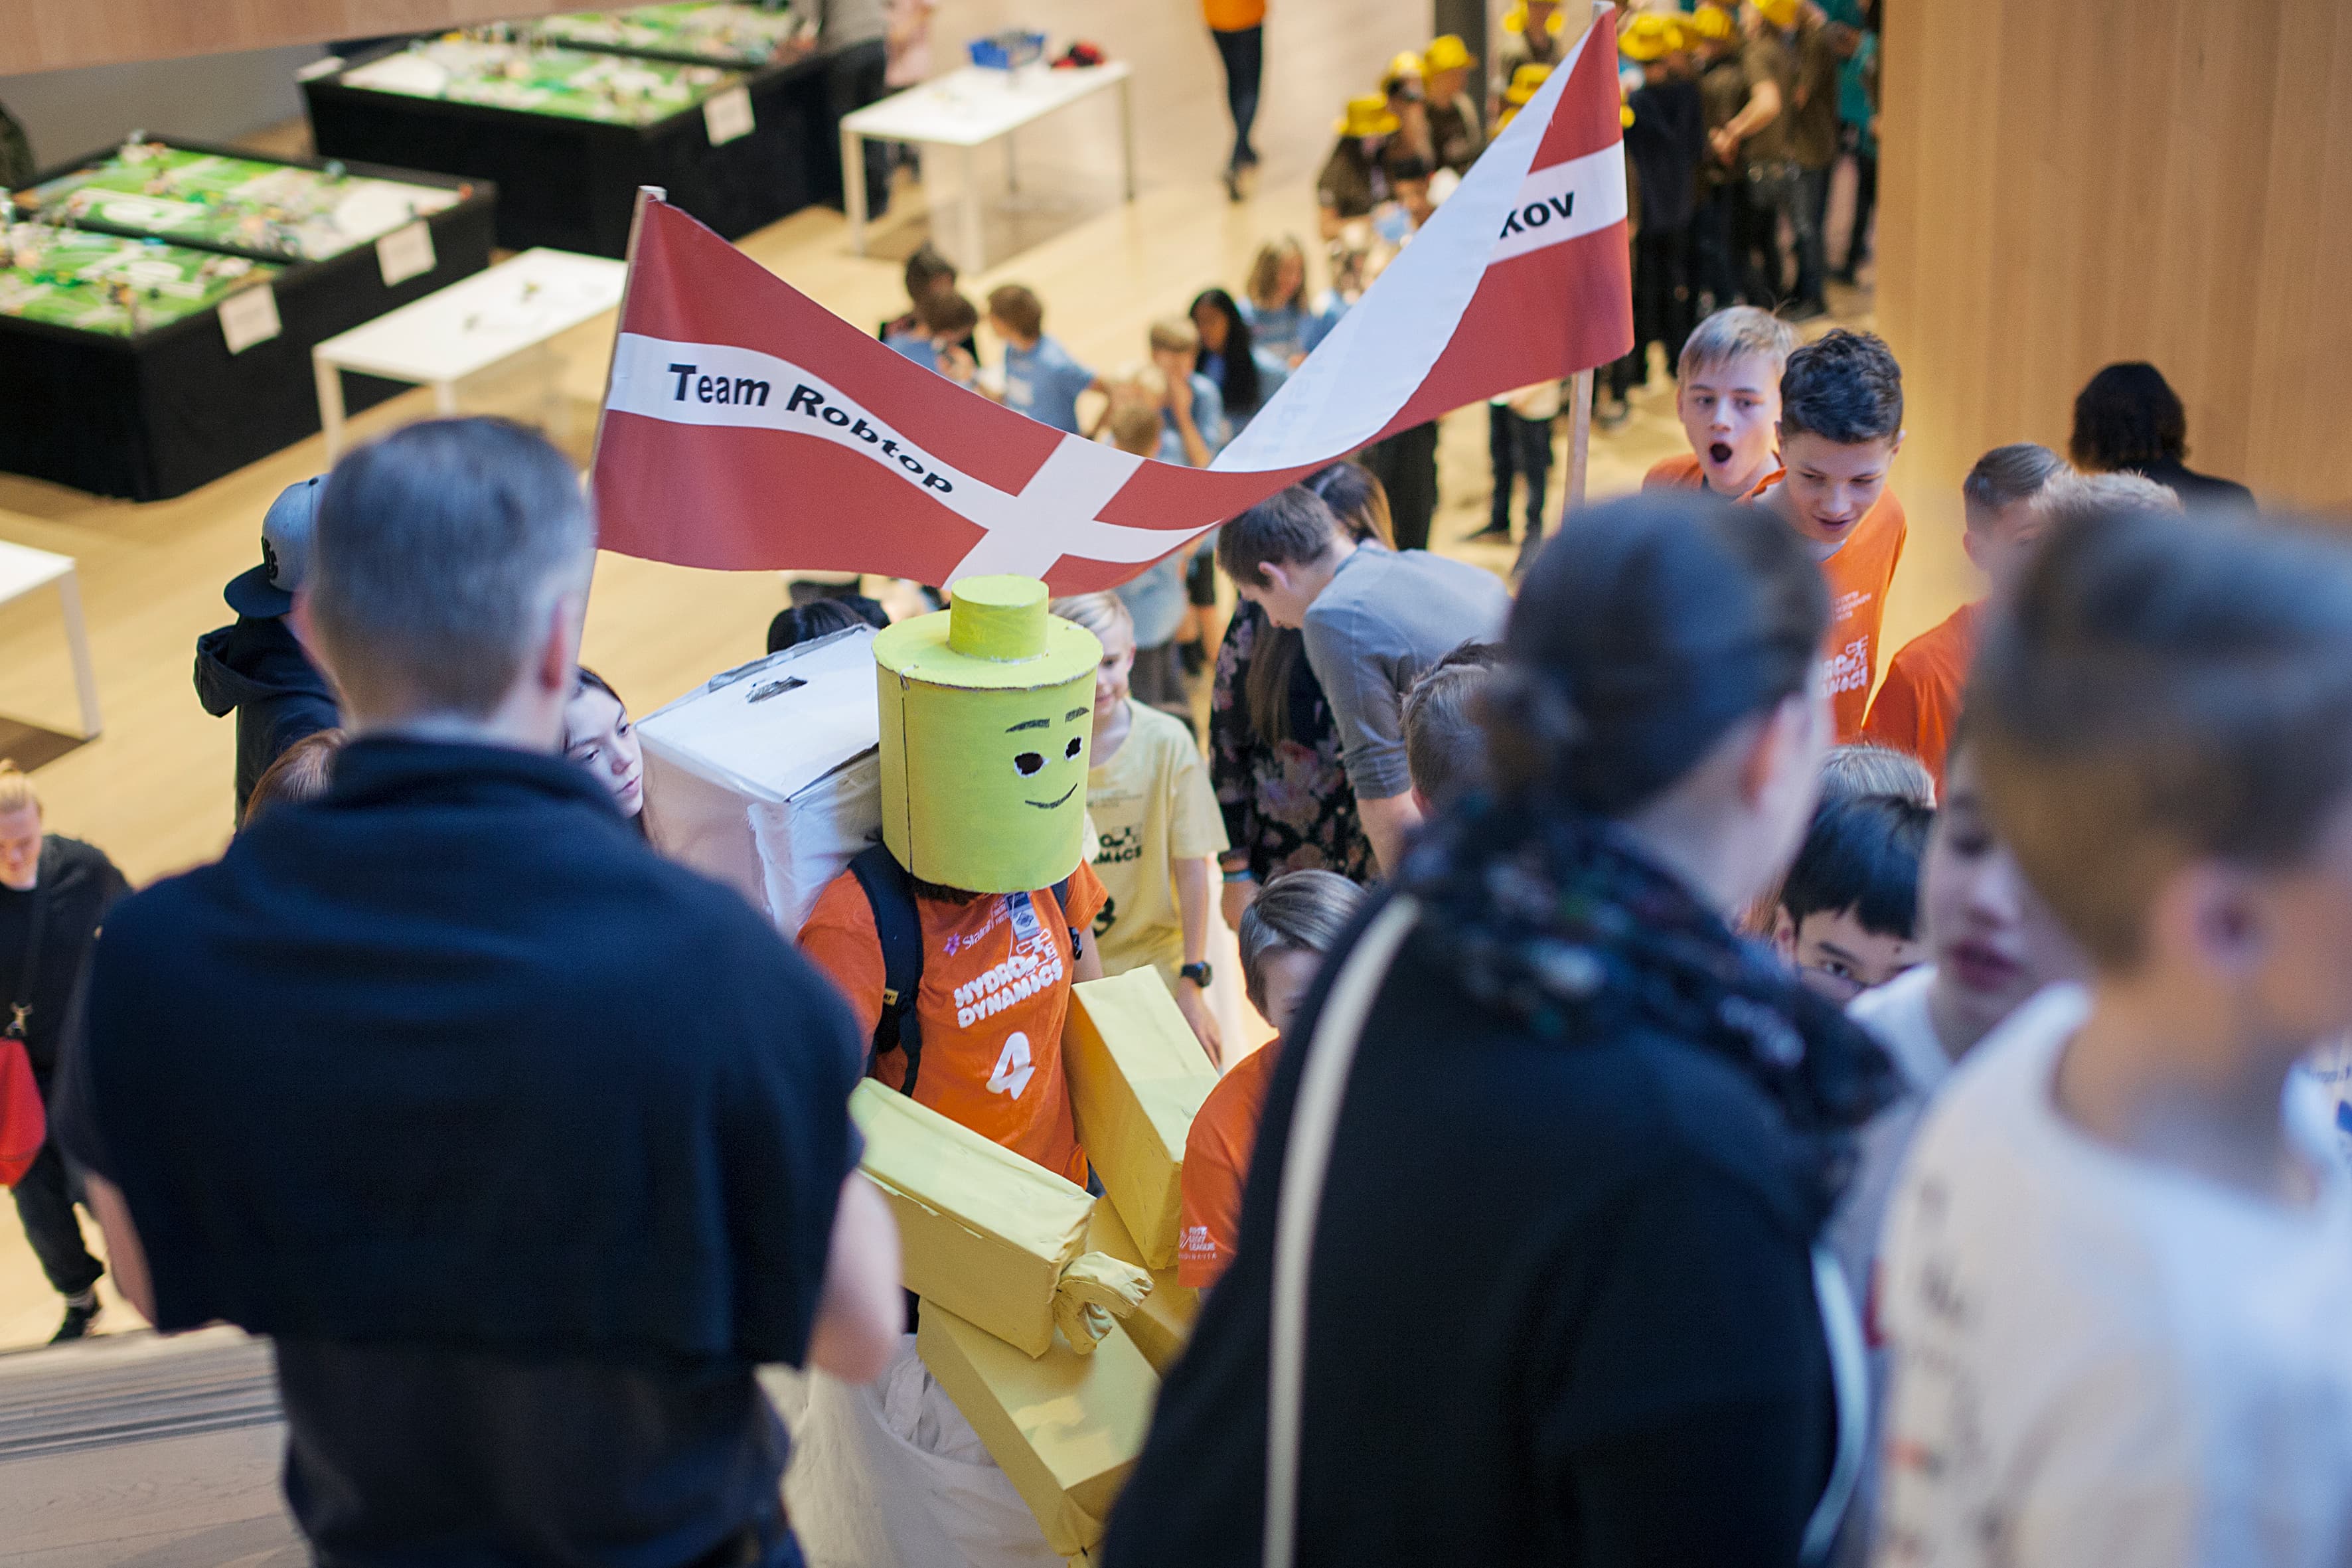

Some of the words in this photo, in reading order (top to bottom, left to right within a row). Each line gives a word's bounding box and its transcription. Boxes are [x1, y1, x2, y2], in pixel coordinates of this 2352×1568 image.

[668, 363, 770, 407] Team
[785, 383, 953, 493] Robtop
[954, 955, 1027, 1008] HYDRO
[957, 959, 1063, 1028] DYNAMICS
[985, 1031, 1036, 1100] 4
